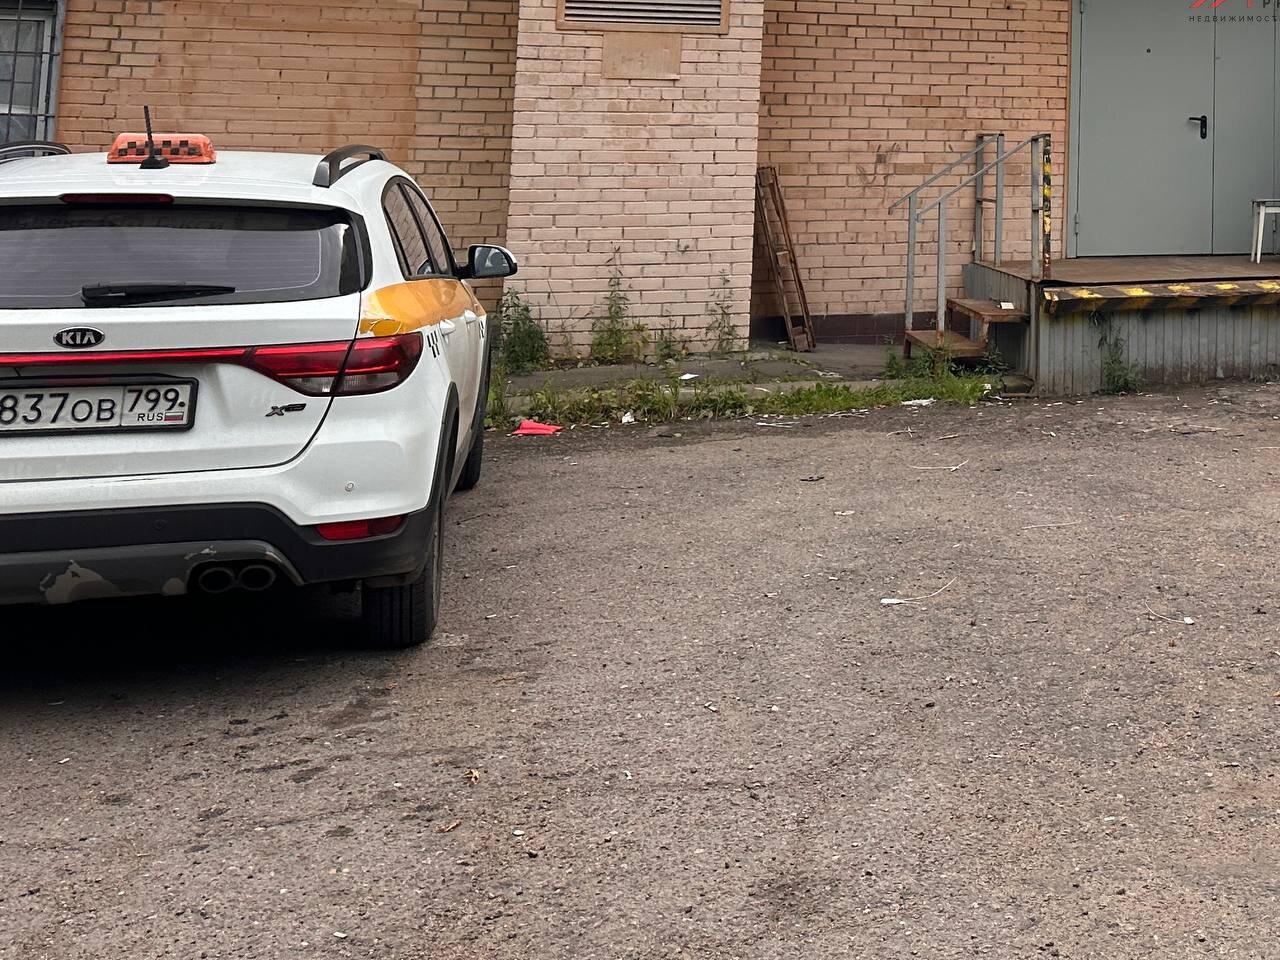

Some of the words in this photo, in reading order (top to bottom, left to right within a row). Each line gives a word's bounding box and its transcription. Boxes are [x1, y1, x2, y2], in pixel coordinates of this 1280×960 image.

[62, 332, 96, 345] KIA
[127, 388, 180, 412] 799
[137, 412, 163, 422] RUS
